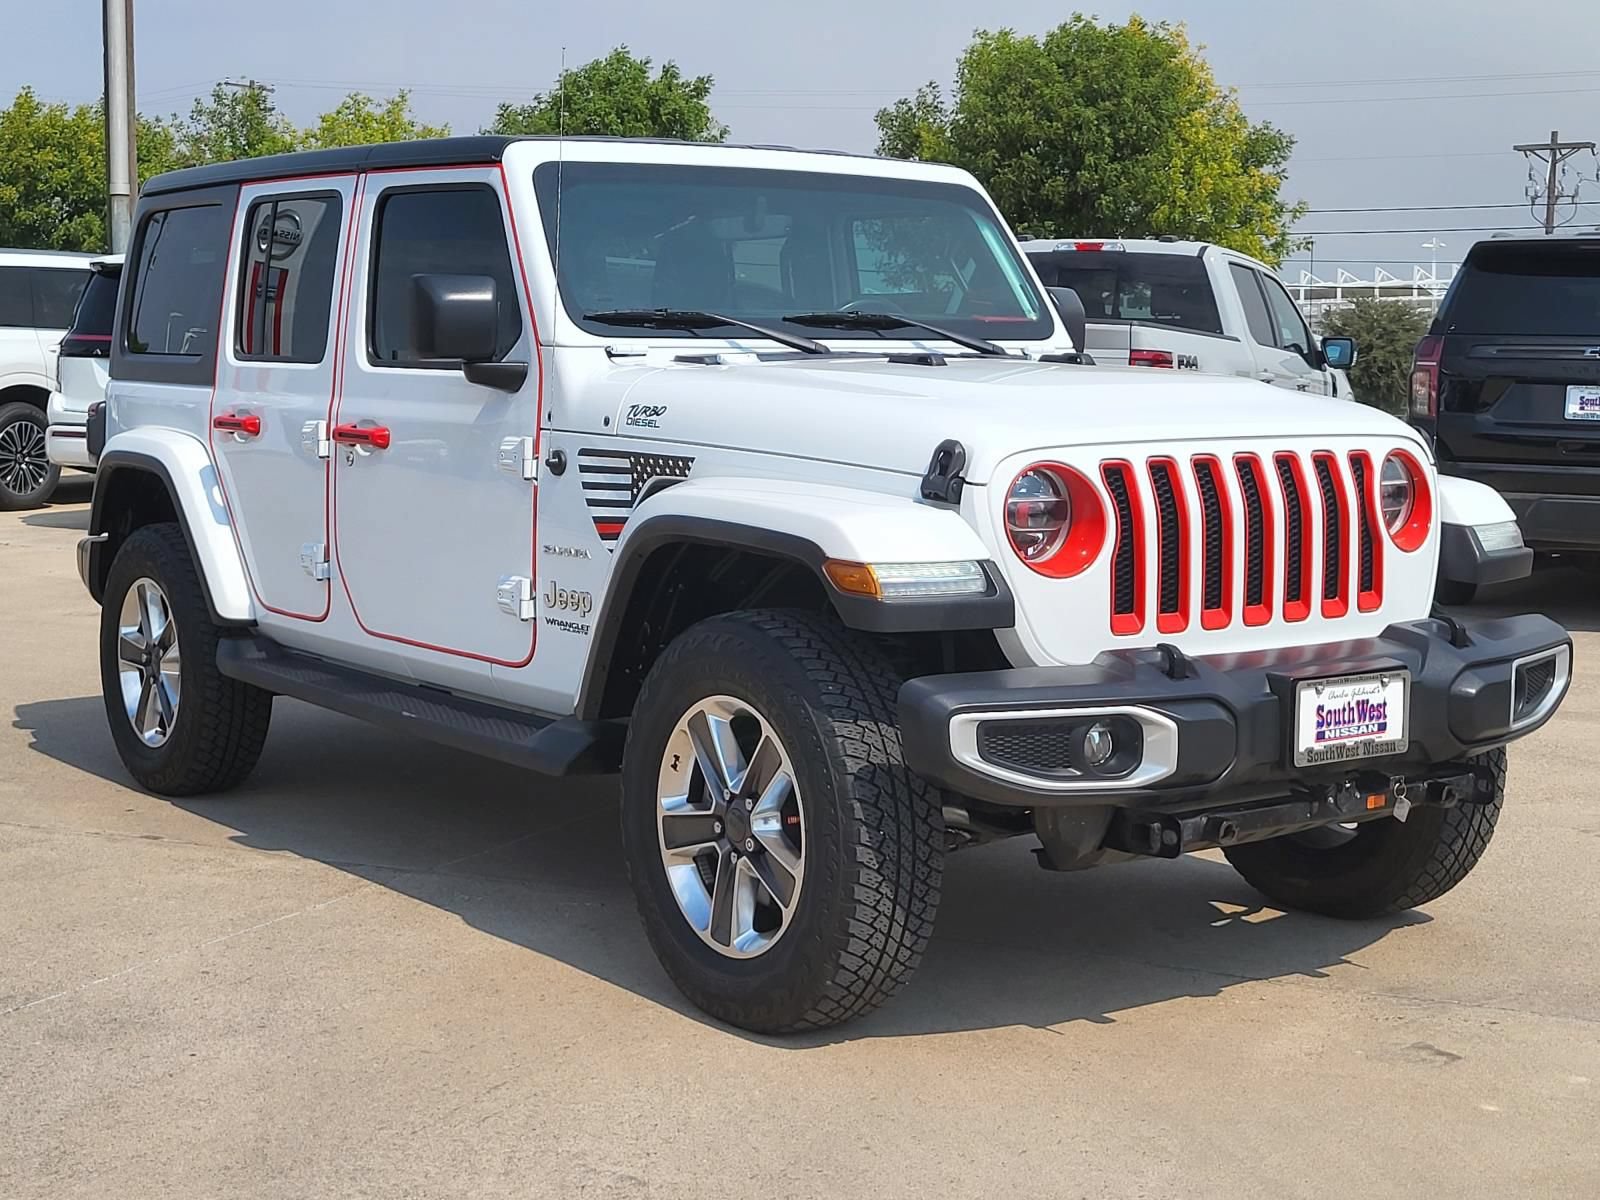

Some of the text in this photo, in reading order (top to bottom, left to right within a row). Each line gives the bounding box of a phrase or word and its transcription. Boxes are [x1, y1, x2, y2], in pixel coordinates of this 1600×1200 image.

[627, 404, 667, 417] TURBO
[626, 417, 660, 428] DIESEL
[544, 581, 592, 618] Jeep
[1324, 722, 1379, 739] NISSAN
[1363, 740, 1396, 756] Nissan
